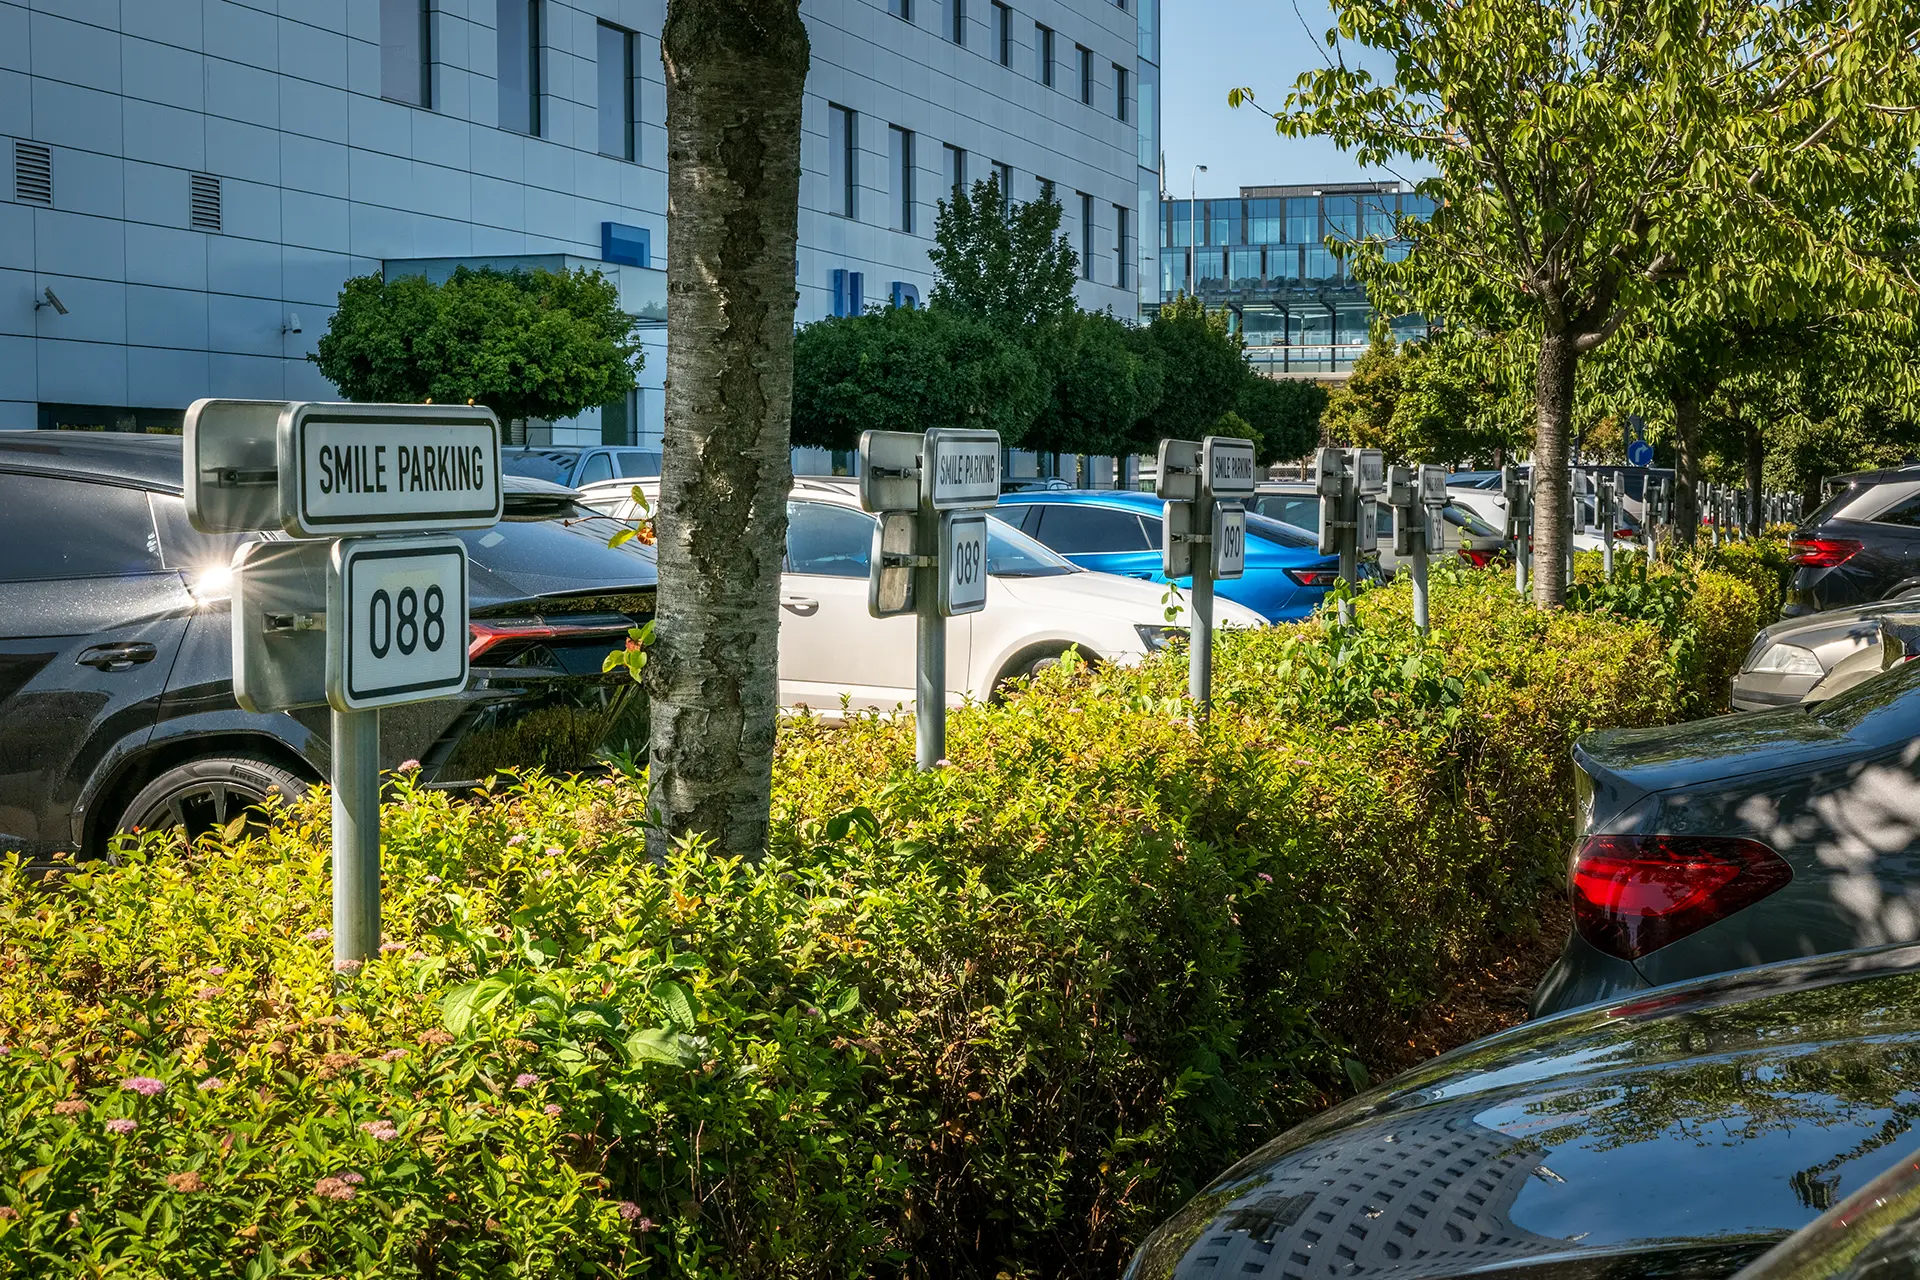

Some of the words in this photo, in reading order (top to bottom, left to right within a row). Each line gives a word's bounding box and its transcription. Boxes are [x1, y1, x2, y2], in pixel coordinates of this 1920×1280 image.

[319, 444, 387, 494] SMILE
[398, 445, 483, 492] PARKING
[940, 454, 963, 485] SMILE
[965, 454, 995, 484] PARKING
[956, 540, 980, 586] 089
[1224, 525, 1240, 558] 090
[370, 584, 445, 659] 088
